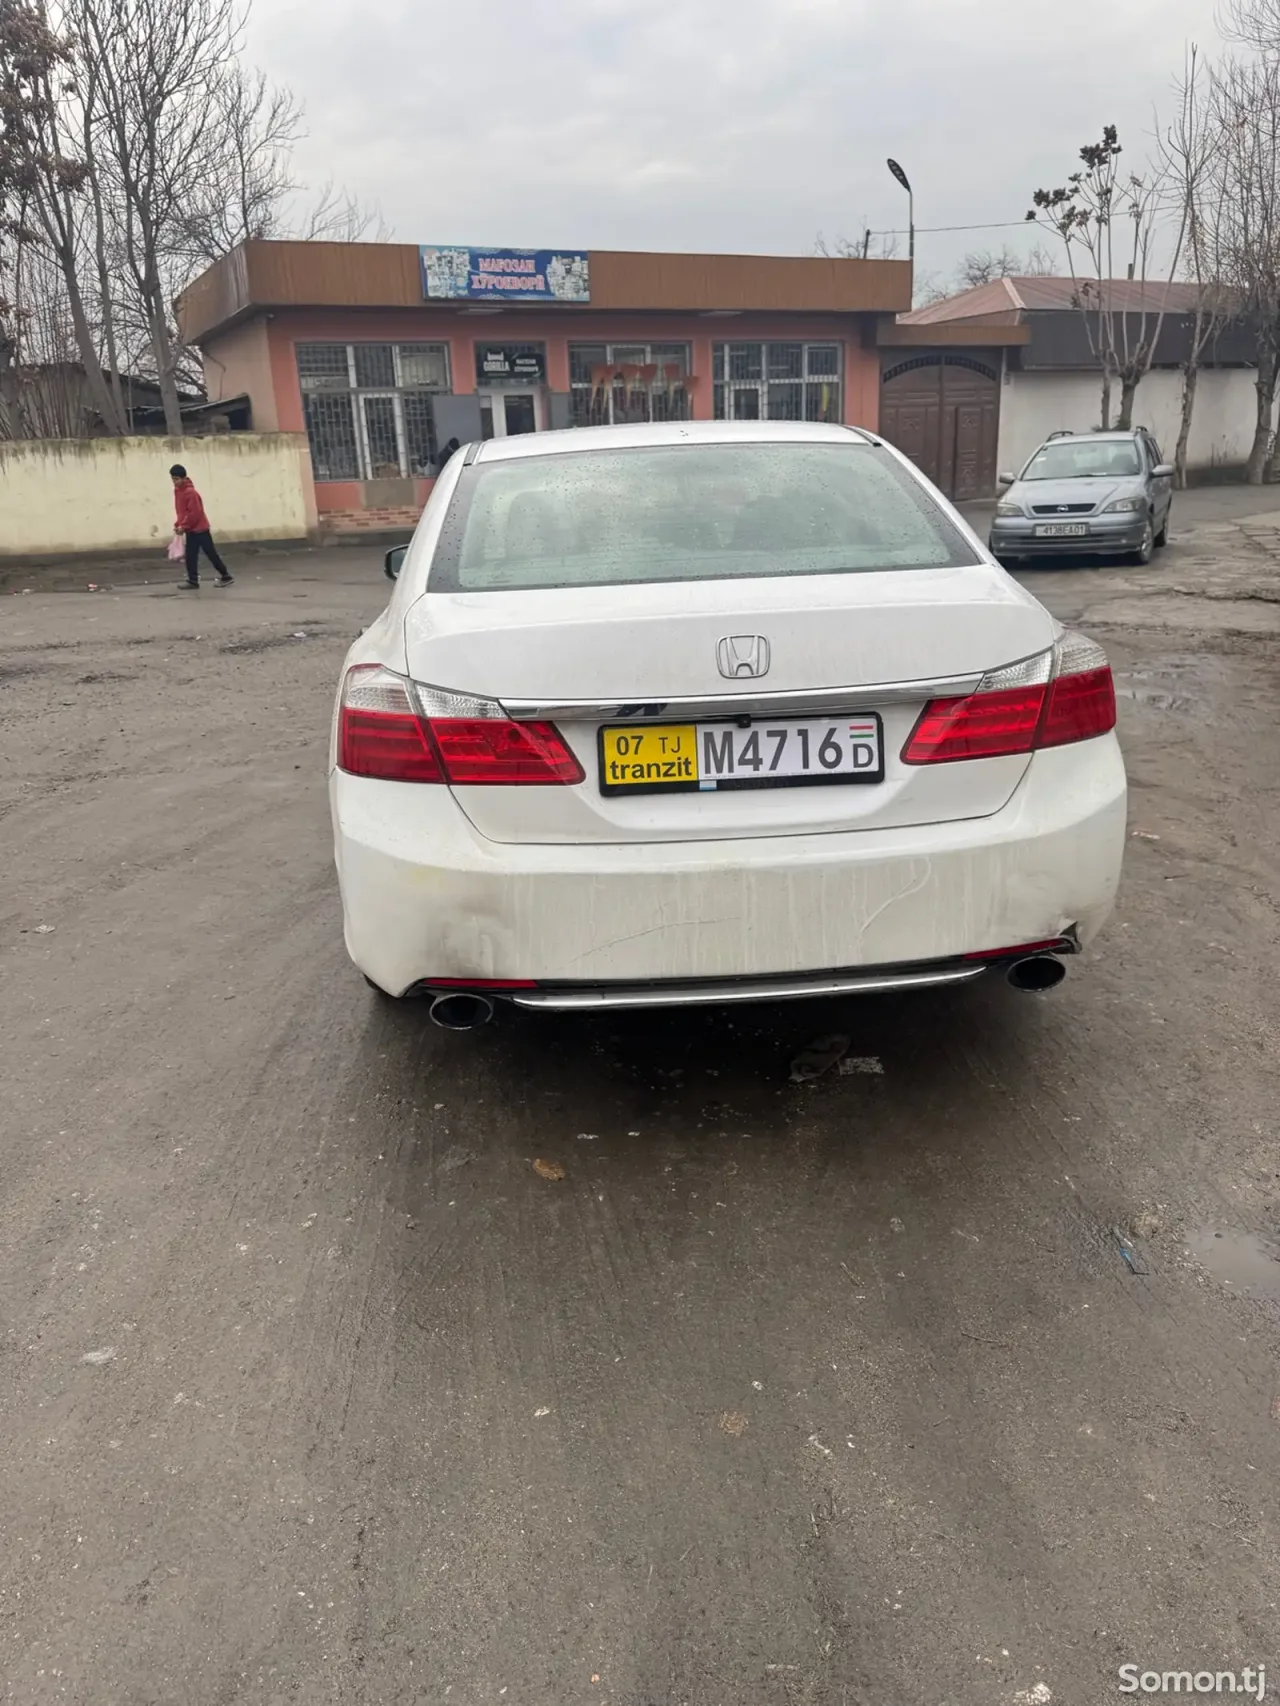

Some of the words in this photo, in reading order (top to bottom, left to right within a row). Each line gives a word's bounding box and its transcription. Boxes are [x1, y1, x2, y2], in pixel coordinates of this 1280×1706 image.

[483, 361, 510, 372] GORILLA
[616, 735, 644, 756] 07
[658, 736, 681, 754] TJ
[703, 727, 843, 775] M4716
[852, 743, 874, 769] D
[610, 757, 692, 780] tranzit
